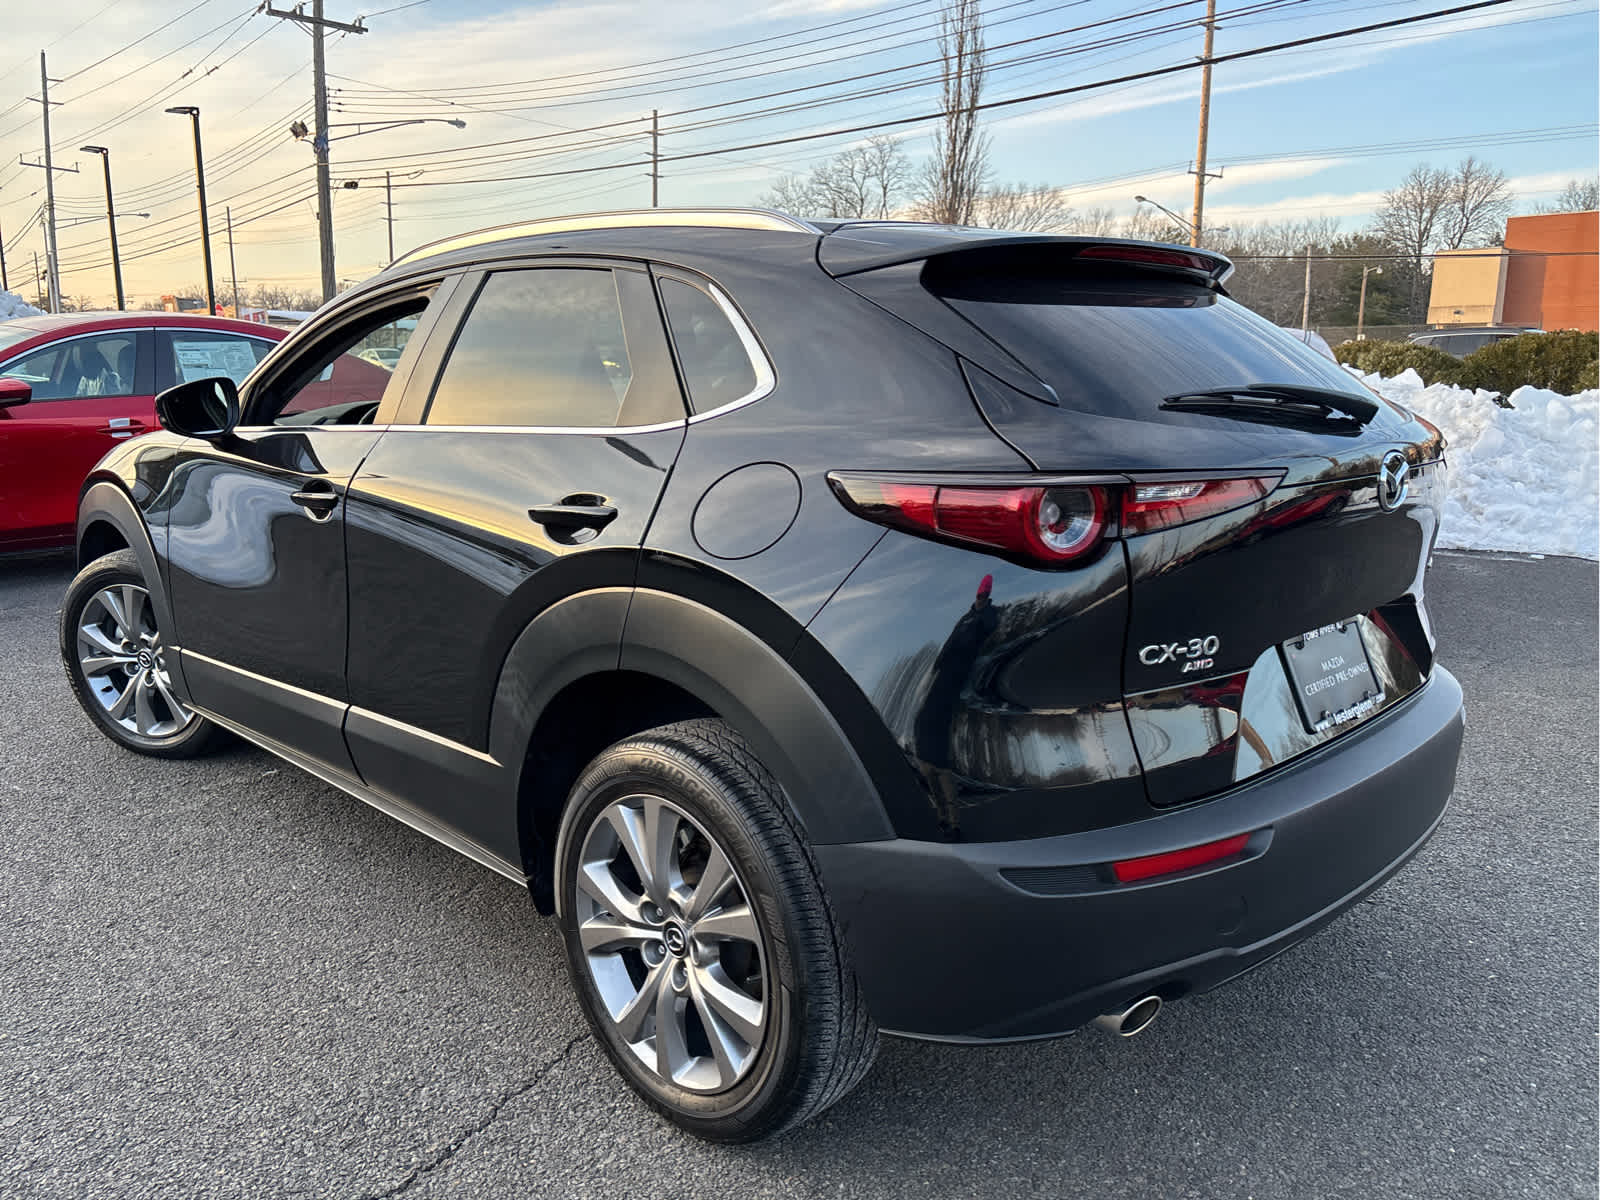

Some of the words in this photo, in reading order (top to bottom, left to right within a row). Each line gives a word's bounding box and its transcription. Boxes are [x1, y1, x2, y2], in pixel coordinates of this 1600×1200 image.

[1138, 635, 1220, 665] CX-30
[1181, 658, 1214, 673] AWD
[1320, 656, 1345, 672] MAZDA
[1304, 676, 1336, 697] CERTIFIED
[1335, 662, 1370, 684] PRE-OWNED
